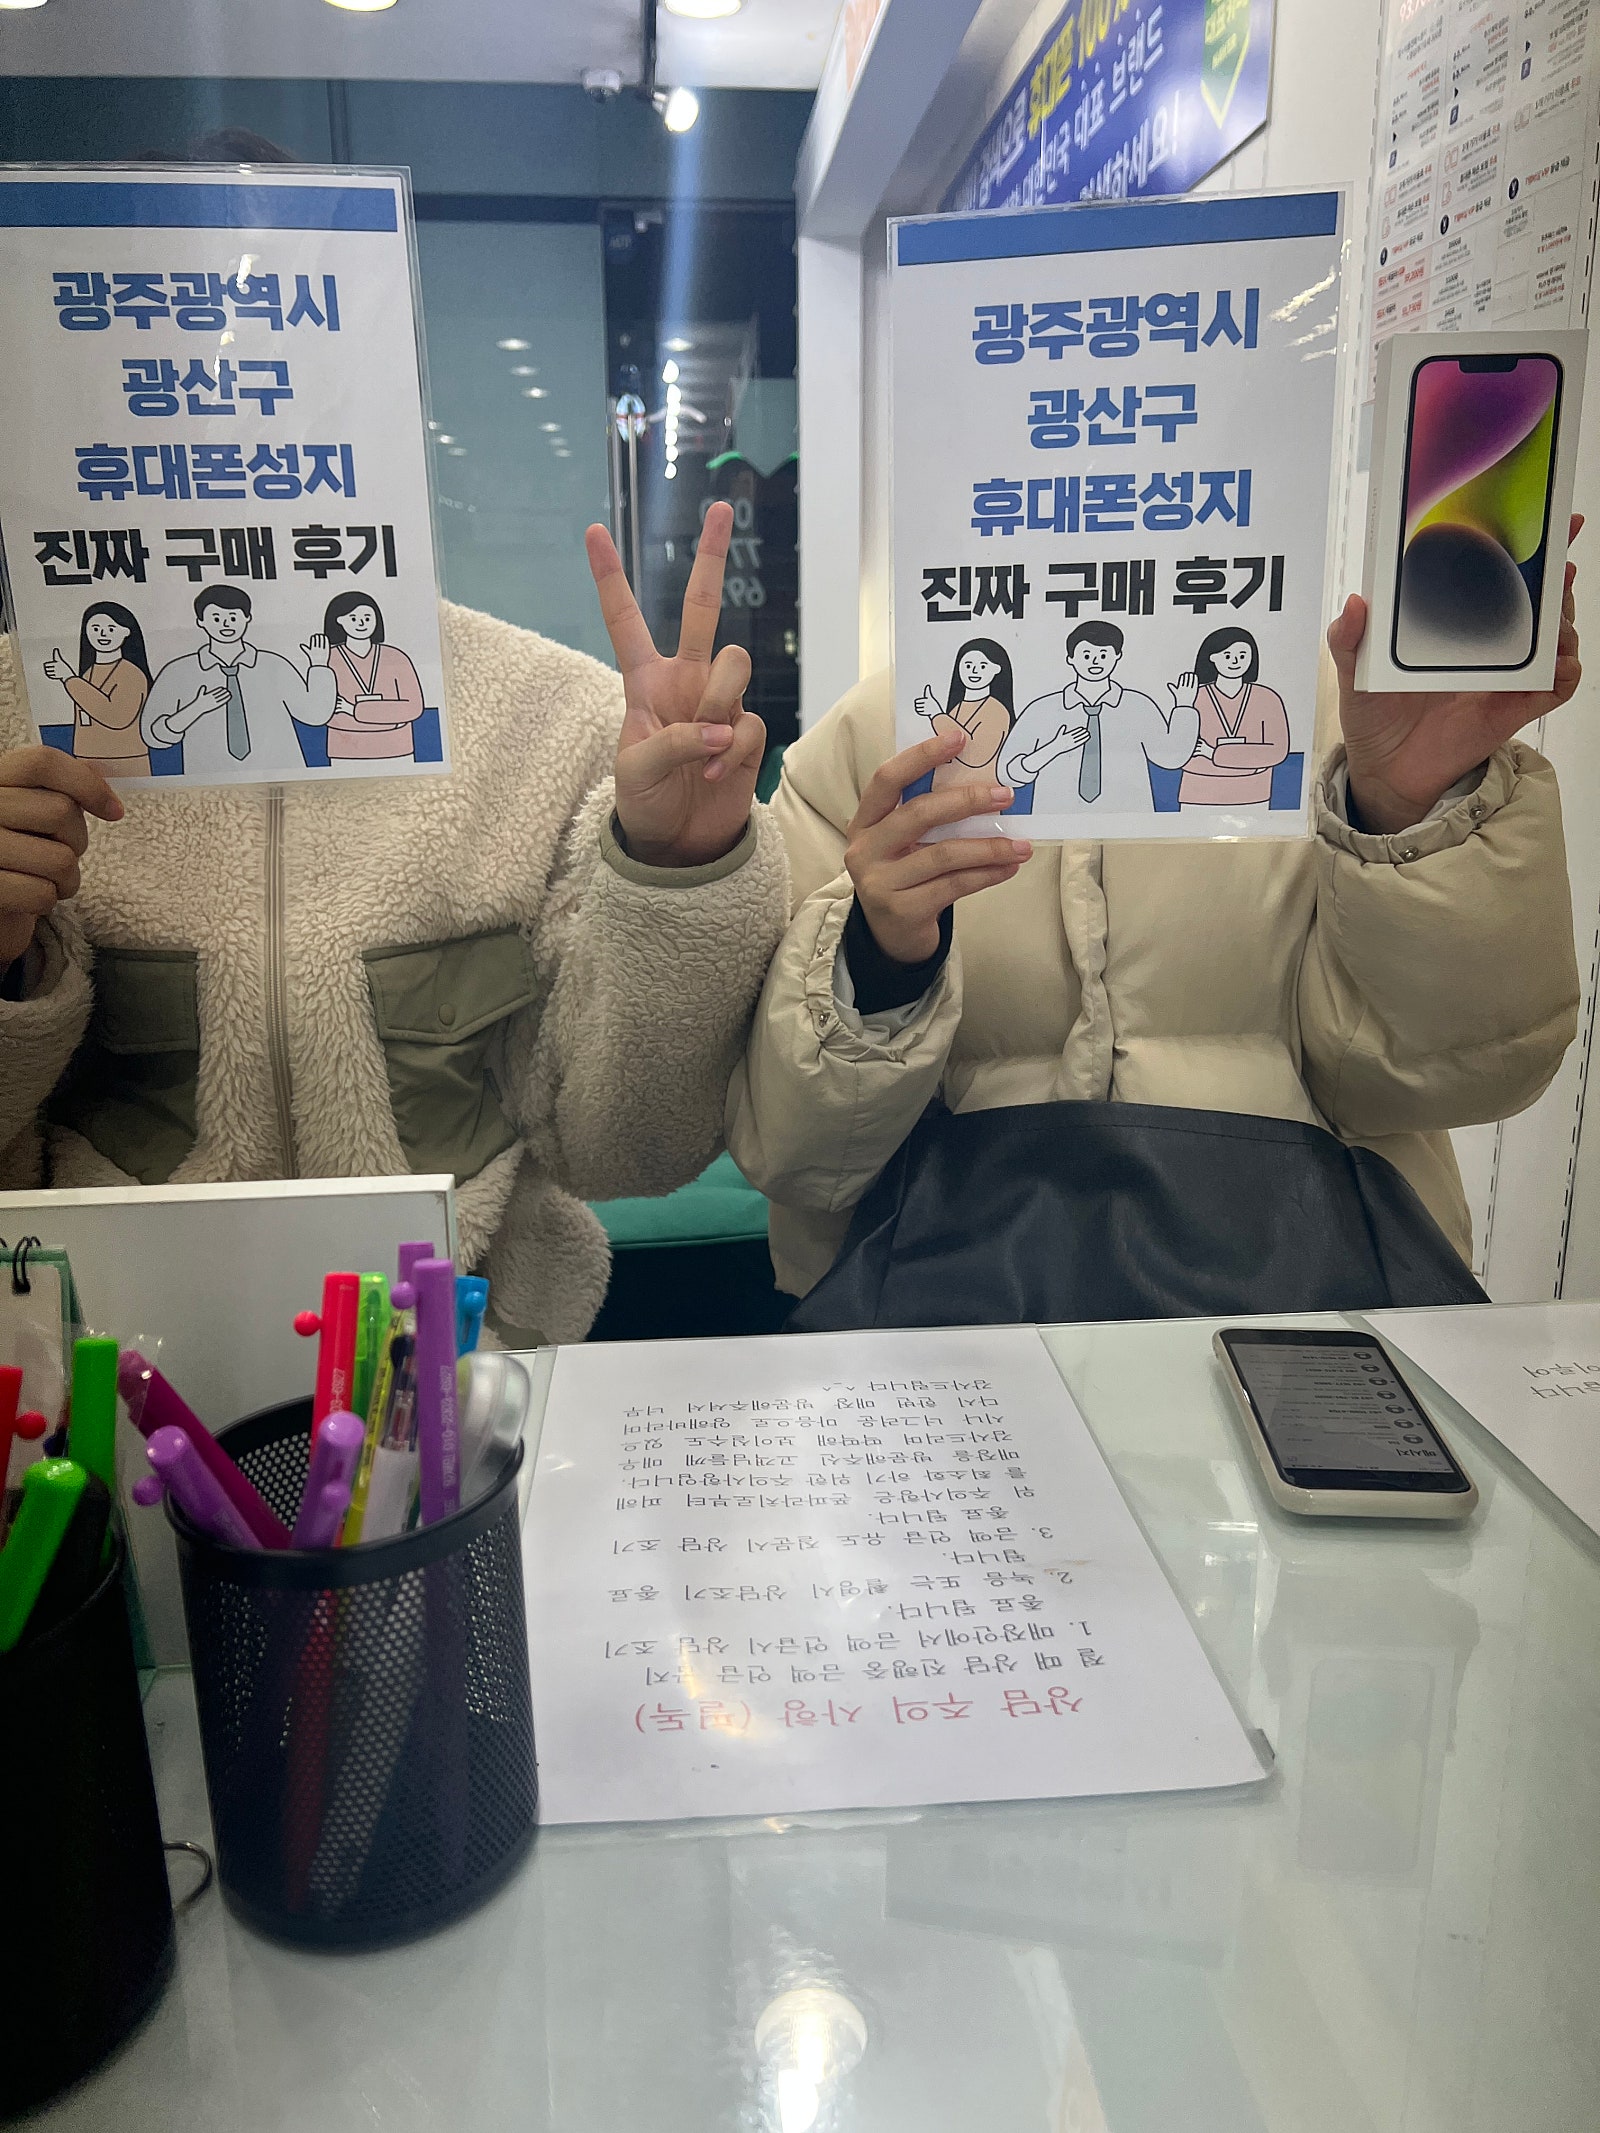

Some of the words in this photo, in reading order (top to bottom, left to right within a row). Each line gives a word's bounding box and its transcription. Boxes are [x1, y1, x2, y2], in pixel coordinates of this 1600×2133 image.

[1073, 77, 1106, 151] 대표
[1109, 4, 1164, 114] 브랜드
[52, 271, 341, 332] 광주광역시
[971, 287, 1260, 366] 광주광역시
[122, 357, 295, 418] 광산구
[1026, 383, 1198, 450] 광산구
[74, 443, 357, 501] 휴대폰성지
[970, 469, 1252, 536] 휴대폰성지
[33, 528, 150, 586] 진짜
[165, 525, 278, 582] 구매
[291, 523, 399, 579] 후기
[919, 563, 1031, 622] 진짜
[1045, 557, 1157, 618] 구매
[1172, 554, 1287, 614] 후기
[834, 1397, 875, 1410] 매장
[896, 1397, 935, 1409] 한번
[957, 1395, 998, 1408] 다시
[622, 1405, 664, 1417] 너무
[963, 1413, 1004, 1425] 시나
[623, 1417, 731, 1435] 양해바라며
[750, 1416, 837, 1428] 마음으로
[857, 1415, 943, 1428] 너그러운
[684, 1434, 796, 1447] 보이실수도
[817, 1434, 882, 1447] 딱딱해
[903, 1430, 1012, 1446] 감사드리며
[686, 1453, 798, 1467] 고객님들께
[820, 1451, 934, 1466] 방문해주신
[952, 1448, 1020, 1462] 매장을
[1395, 1447, 1438, 1458] 메시지
[618, 1456, 662, 1471] 매우
[622, 1473, 792, 1489] 주의사항입니다.
[806, 1473, 850, 1486] 위한
[866, 1471, 909, 1484] 하기
[924, 1468, 990, 1481] 최소화
[687, 1492, 852, 1509] 폰파라치로부터
[873, 1487, 990, 1504] 주의사항은
[1013, 1486, 1035, 1498] 위
[616, 1494, 662, 1511] 피해
[868, 1509, 947, 1525] 됩니다.
[960, 1506, 1009, 1520] 종료
[836, 1532, 886, 1547] 유도
[902, 1531, 951, 1545] 언급
[968, 1527, 1018, 1543] 금액
[1031, 1527, 1053, 1539] 3.
[613, 1539, 660, 1555] 조기
[677, 1537, 728, 1552] 상담
[748, 1535, 819, 1553] 질문시
[942, 1549, 1025, 1565] 됩니다.
[910, 1575, 960, 1590] 또는
[982, 1571, 1034, 1587] 녹음
[1049, 1571, 1072, 1584] 2.
[608, 1585, 660, 1603] 종료
[684, 1585, 787, 1602] 상담조기
[812, 1578, 888, 1600] 촬영시
[888, 1599, 976, 1620] 됩니다.
[989, 1594, 1044, 1612] 종료
[918, 1622, 1054, 1648] 매장안에서
[1069, 1620, 1092, 1636] 1.
[605, 1641, 658, 1659] 조기
[674, 1636, 729, 1655] 상담
[749, 1636, 828, 1656] 언급시
[846, 1631, 900, 1653] 금액
[964, 1653, 1018, 1675] 상담
[1034, 1652, 1062, 1671] 때
[1076, 1648, 1104, 1668] 절
[717, 1665, 772, 1684] 언급
[790, 1664, 845, 1684] 금액
[862, 1659, 945, 1679] 진행중
[892, 1691, 973, 1724] 주의
[1000, 1686, 1083, 1718] 상담
[635, 1700, 751, 1734] (필독)
[776, 1698, 862, 1728] 사항
